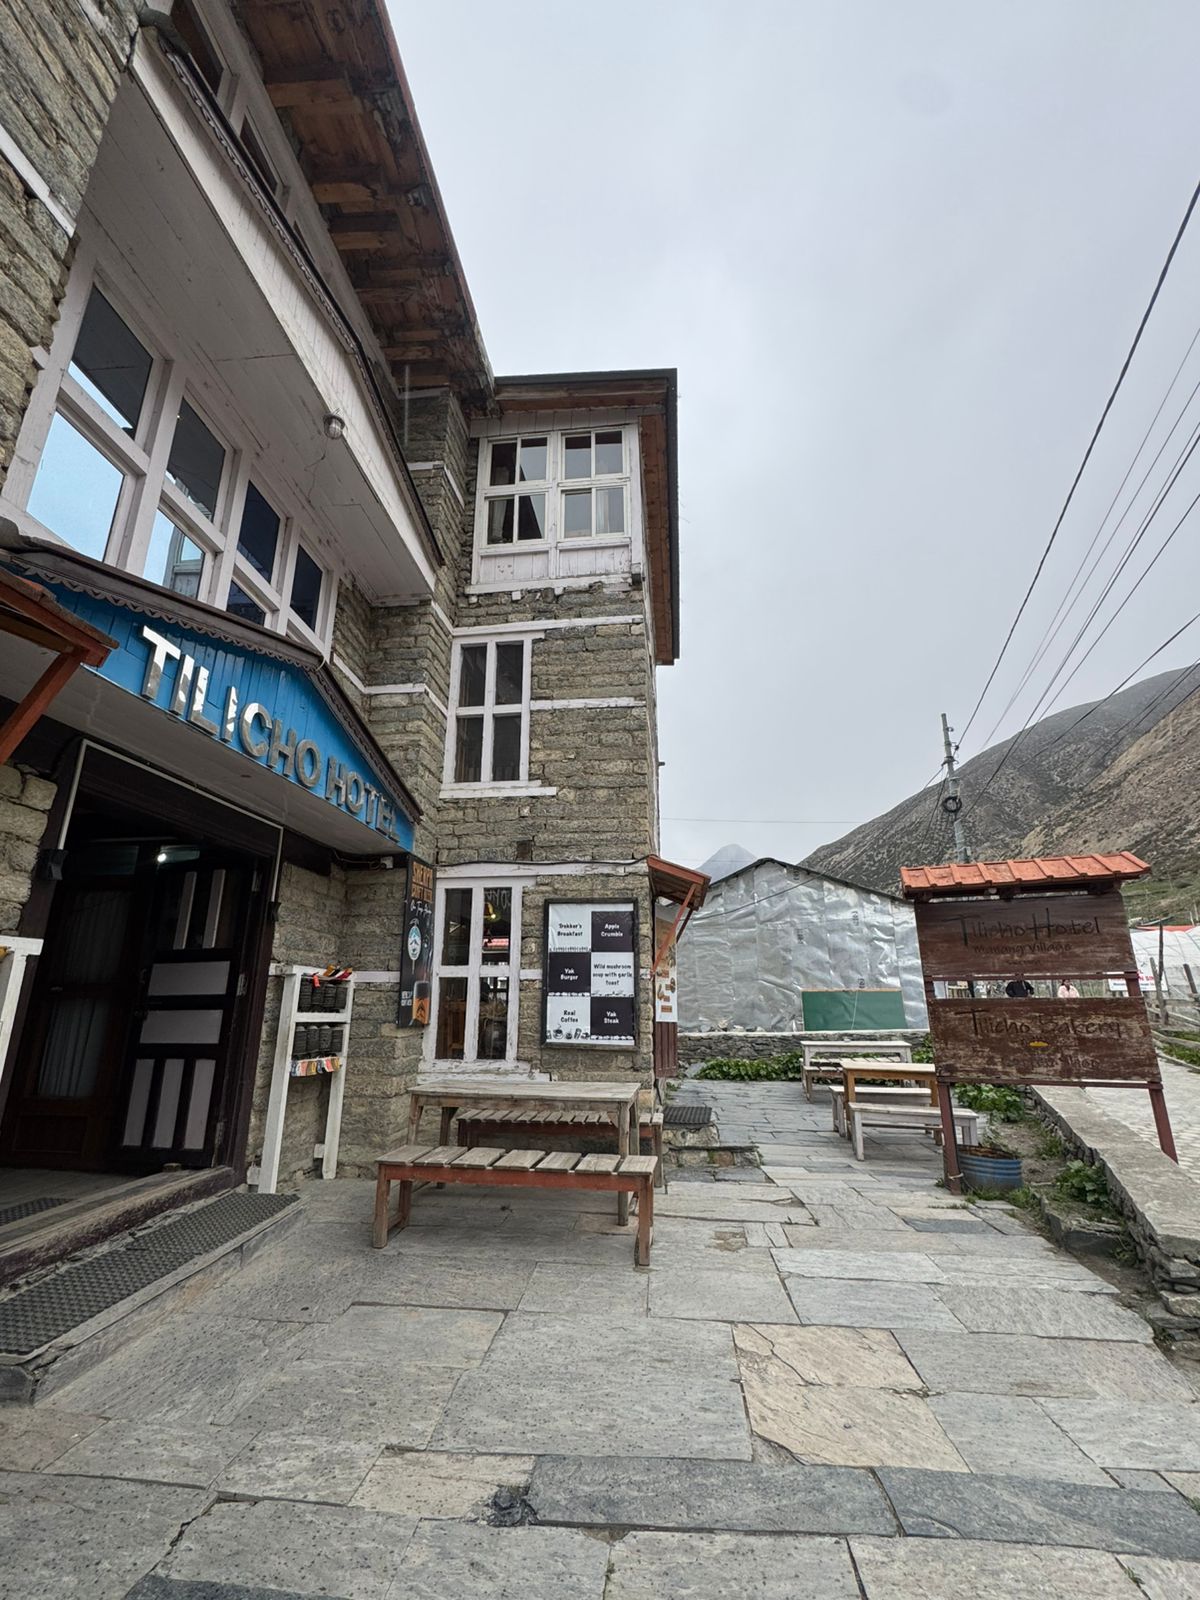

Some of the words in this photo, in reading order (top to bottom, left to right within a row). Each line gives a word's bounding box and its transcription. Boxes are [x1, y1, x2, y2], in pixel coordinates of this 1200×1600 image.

[141, 625, 322, 788] TILICHO
[324, 756, 400, 843] HOTEL
[942, 912, 1025, 946] Tilicho
[1026, 907, 1101, 940] Hotel
[955, 1008, 1030, 1036] Tilicho
[1039, 1013, 1122, 1038] Bakery
